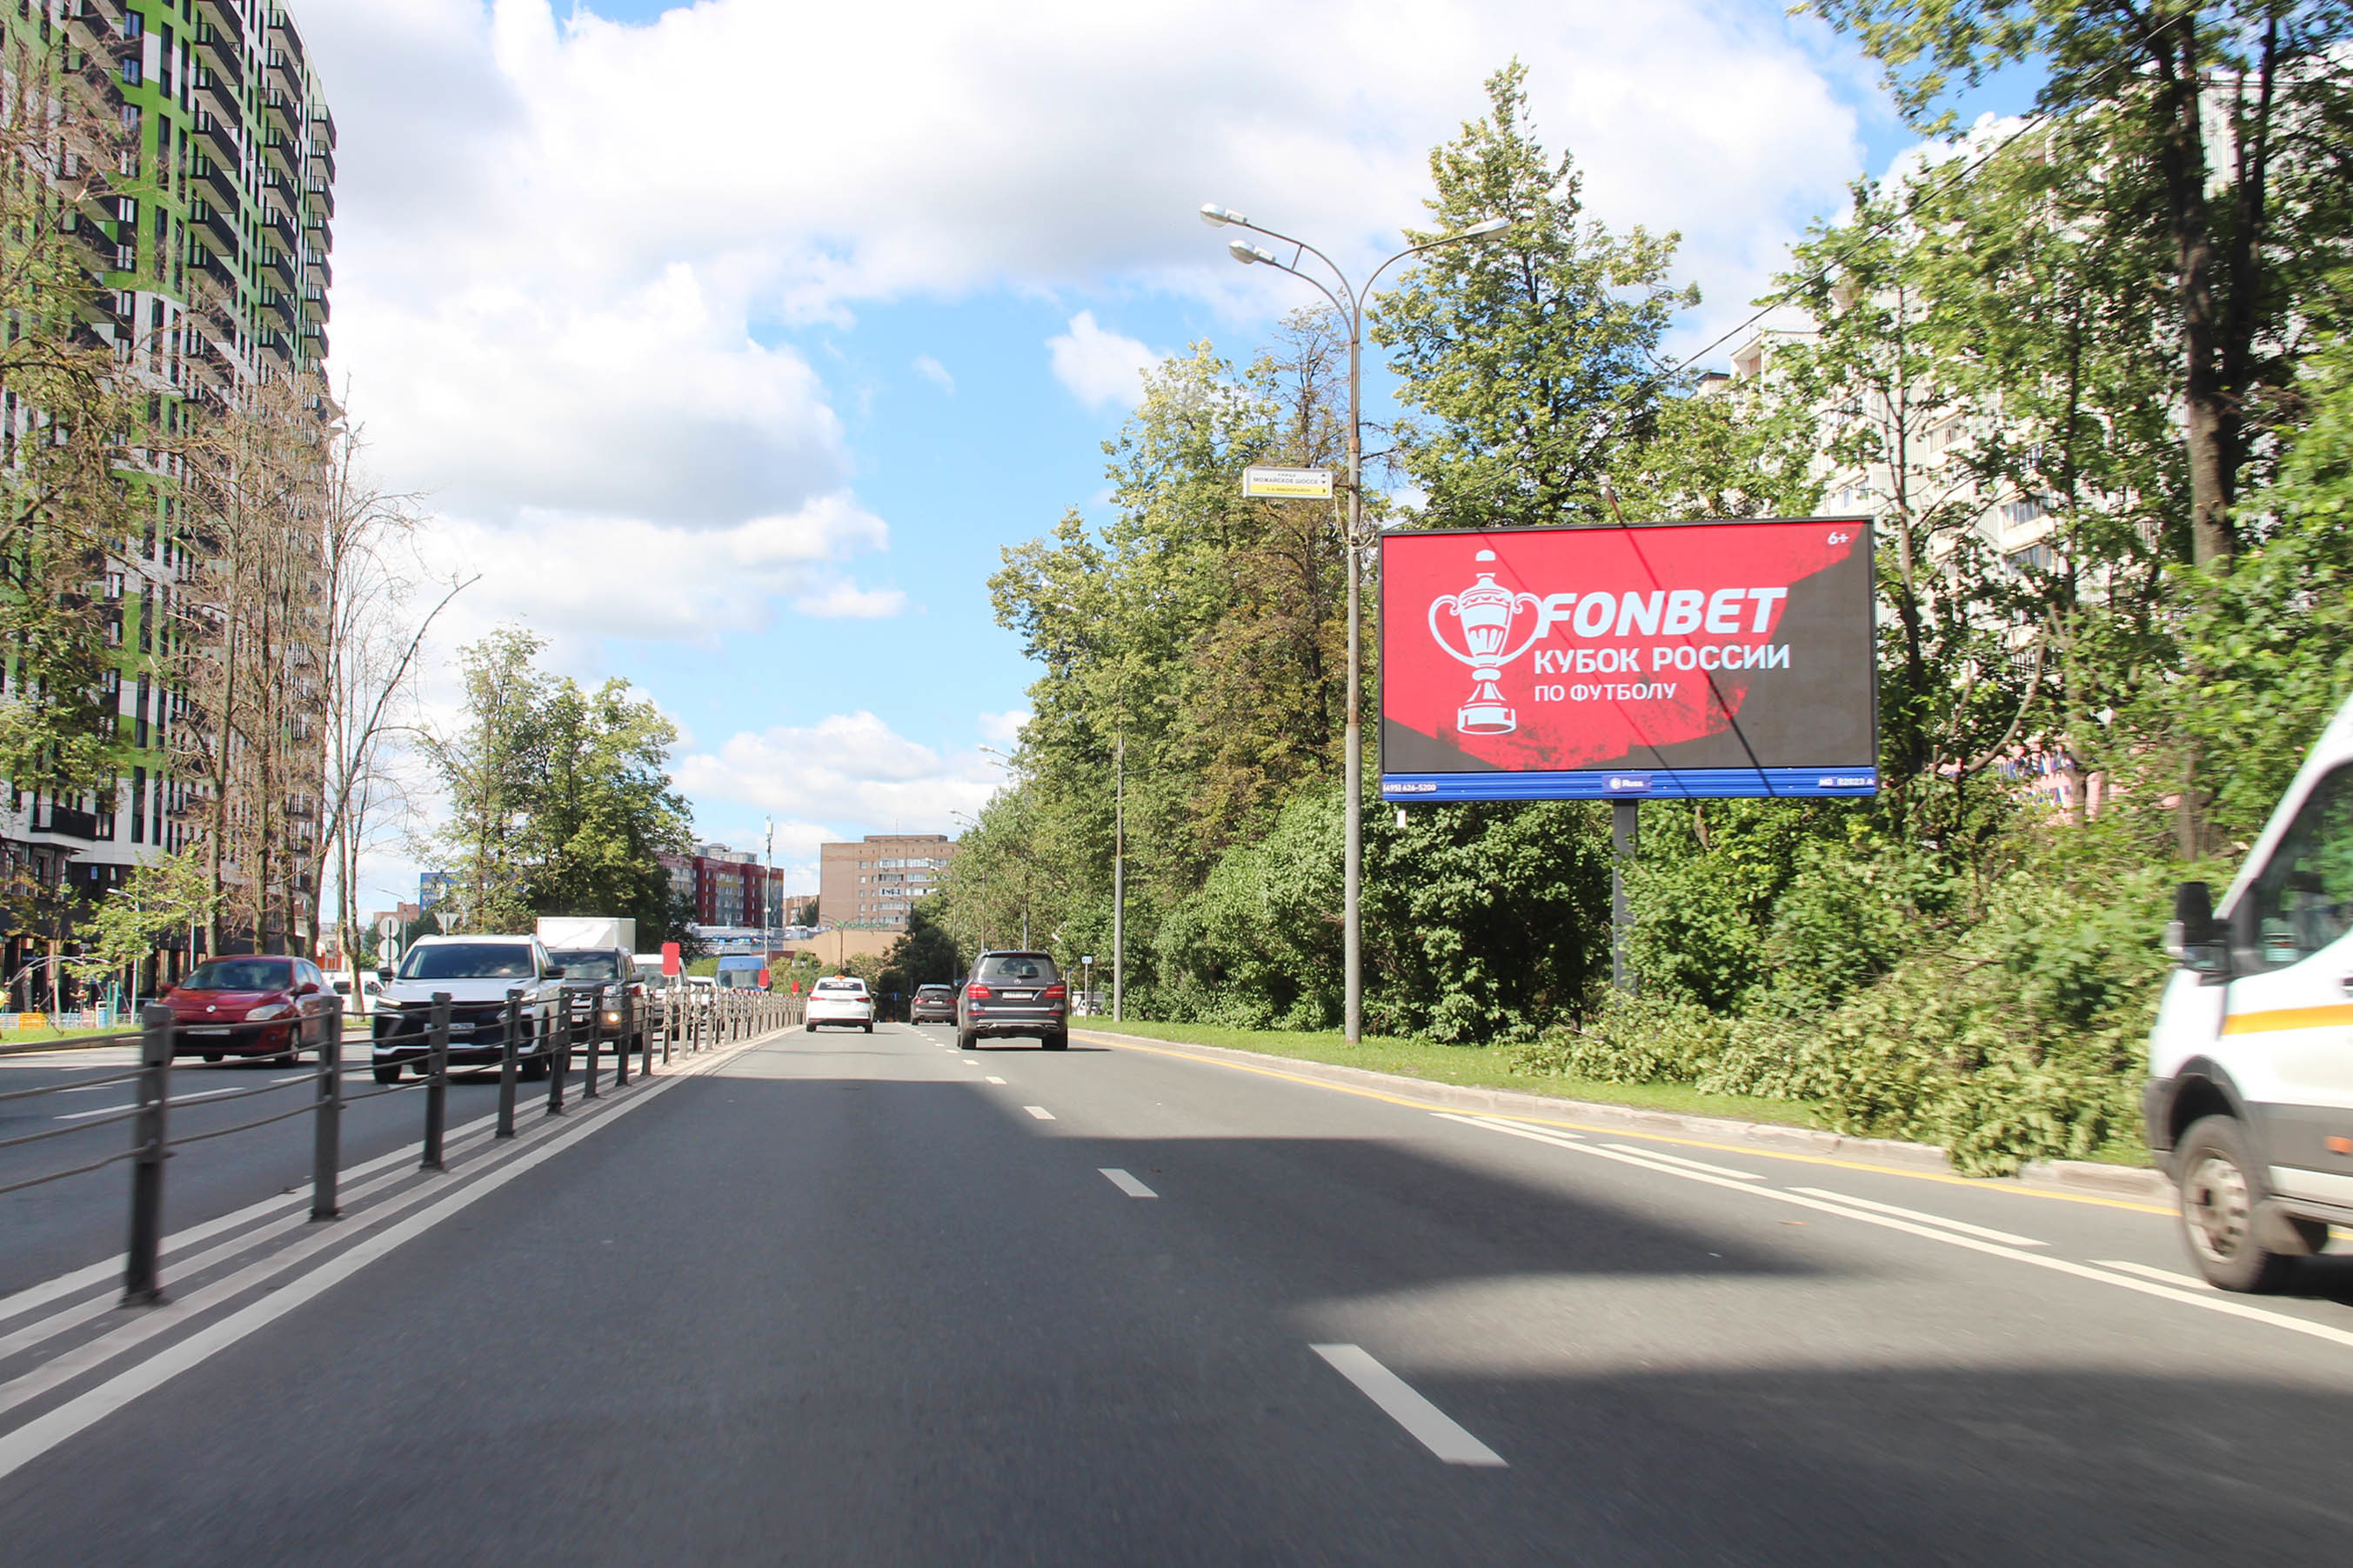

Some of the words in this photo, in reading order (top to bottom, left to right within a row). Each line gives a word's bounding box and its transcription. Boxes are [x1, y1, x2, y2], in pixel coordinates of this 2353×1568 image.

[1828, 531, 1849, 545] 6+
[1535, 587, 1788, 638] FONBET
[1534, 647, 1641, 675] КУБОК
[1653, 644, 1790, 671] РОССИИ
[1534, 684, 1565, 702] ПО
[1569, 683, 1678, 702] ФУТБОЛУ
[1402, 783, 1437, 791] 626-5200
